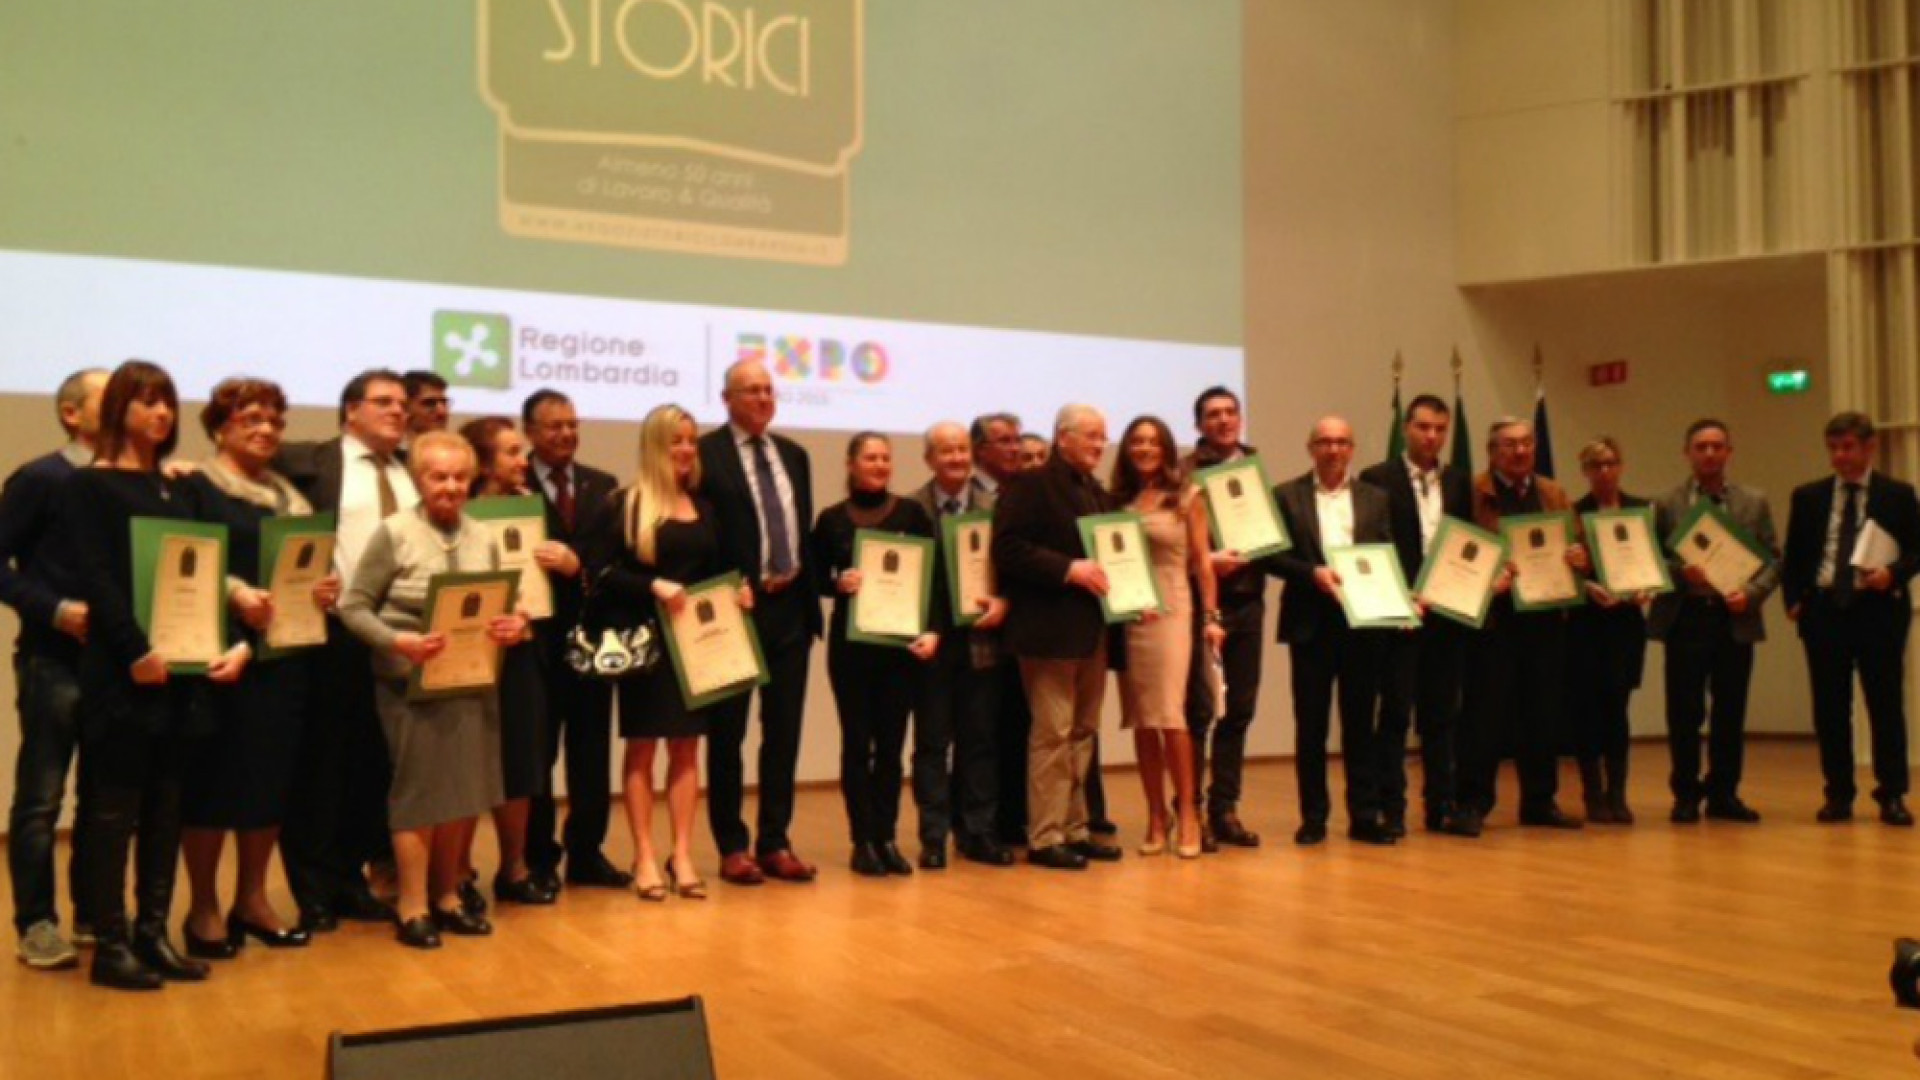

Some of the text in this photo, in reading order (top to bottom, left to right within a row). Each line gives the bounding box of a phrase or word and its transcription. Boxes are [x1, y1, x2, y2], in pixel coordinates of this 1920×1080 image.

[542, 0, 809, 97] STORICI
[519, 326, 645, 358] Regione
[736, 332, 889, 384] EXPO
[519, 356, 679, 387] Lombardia
